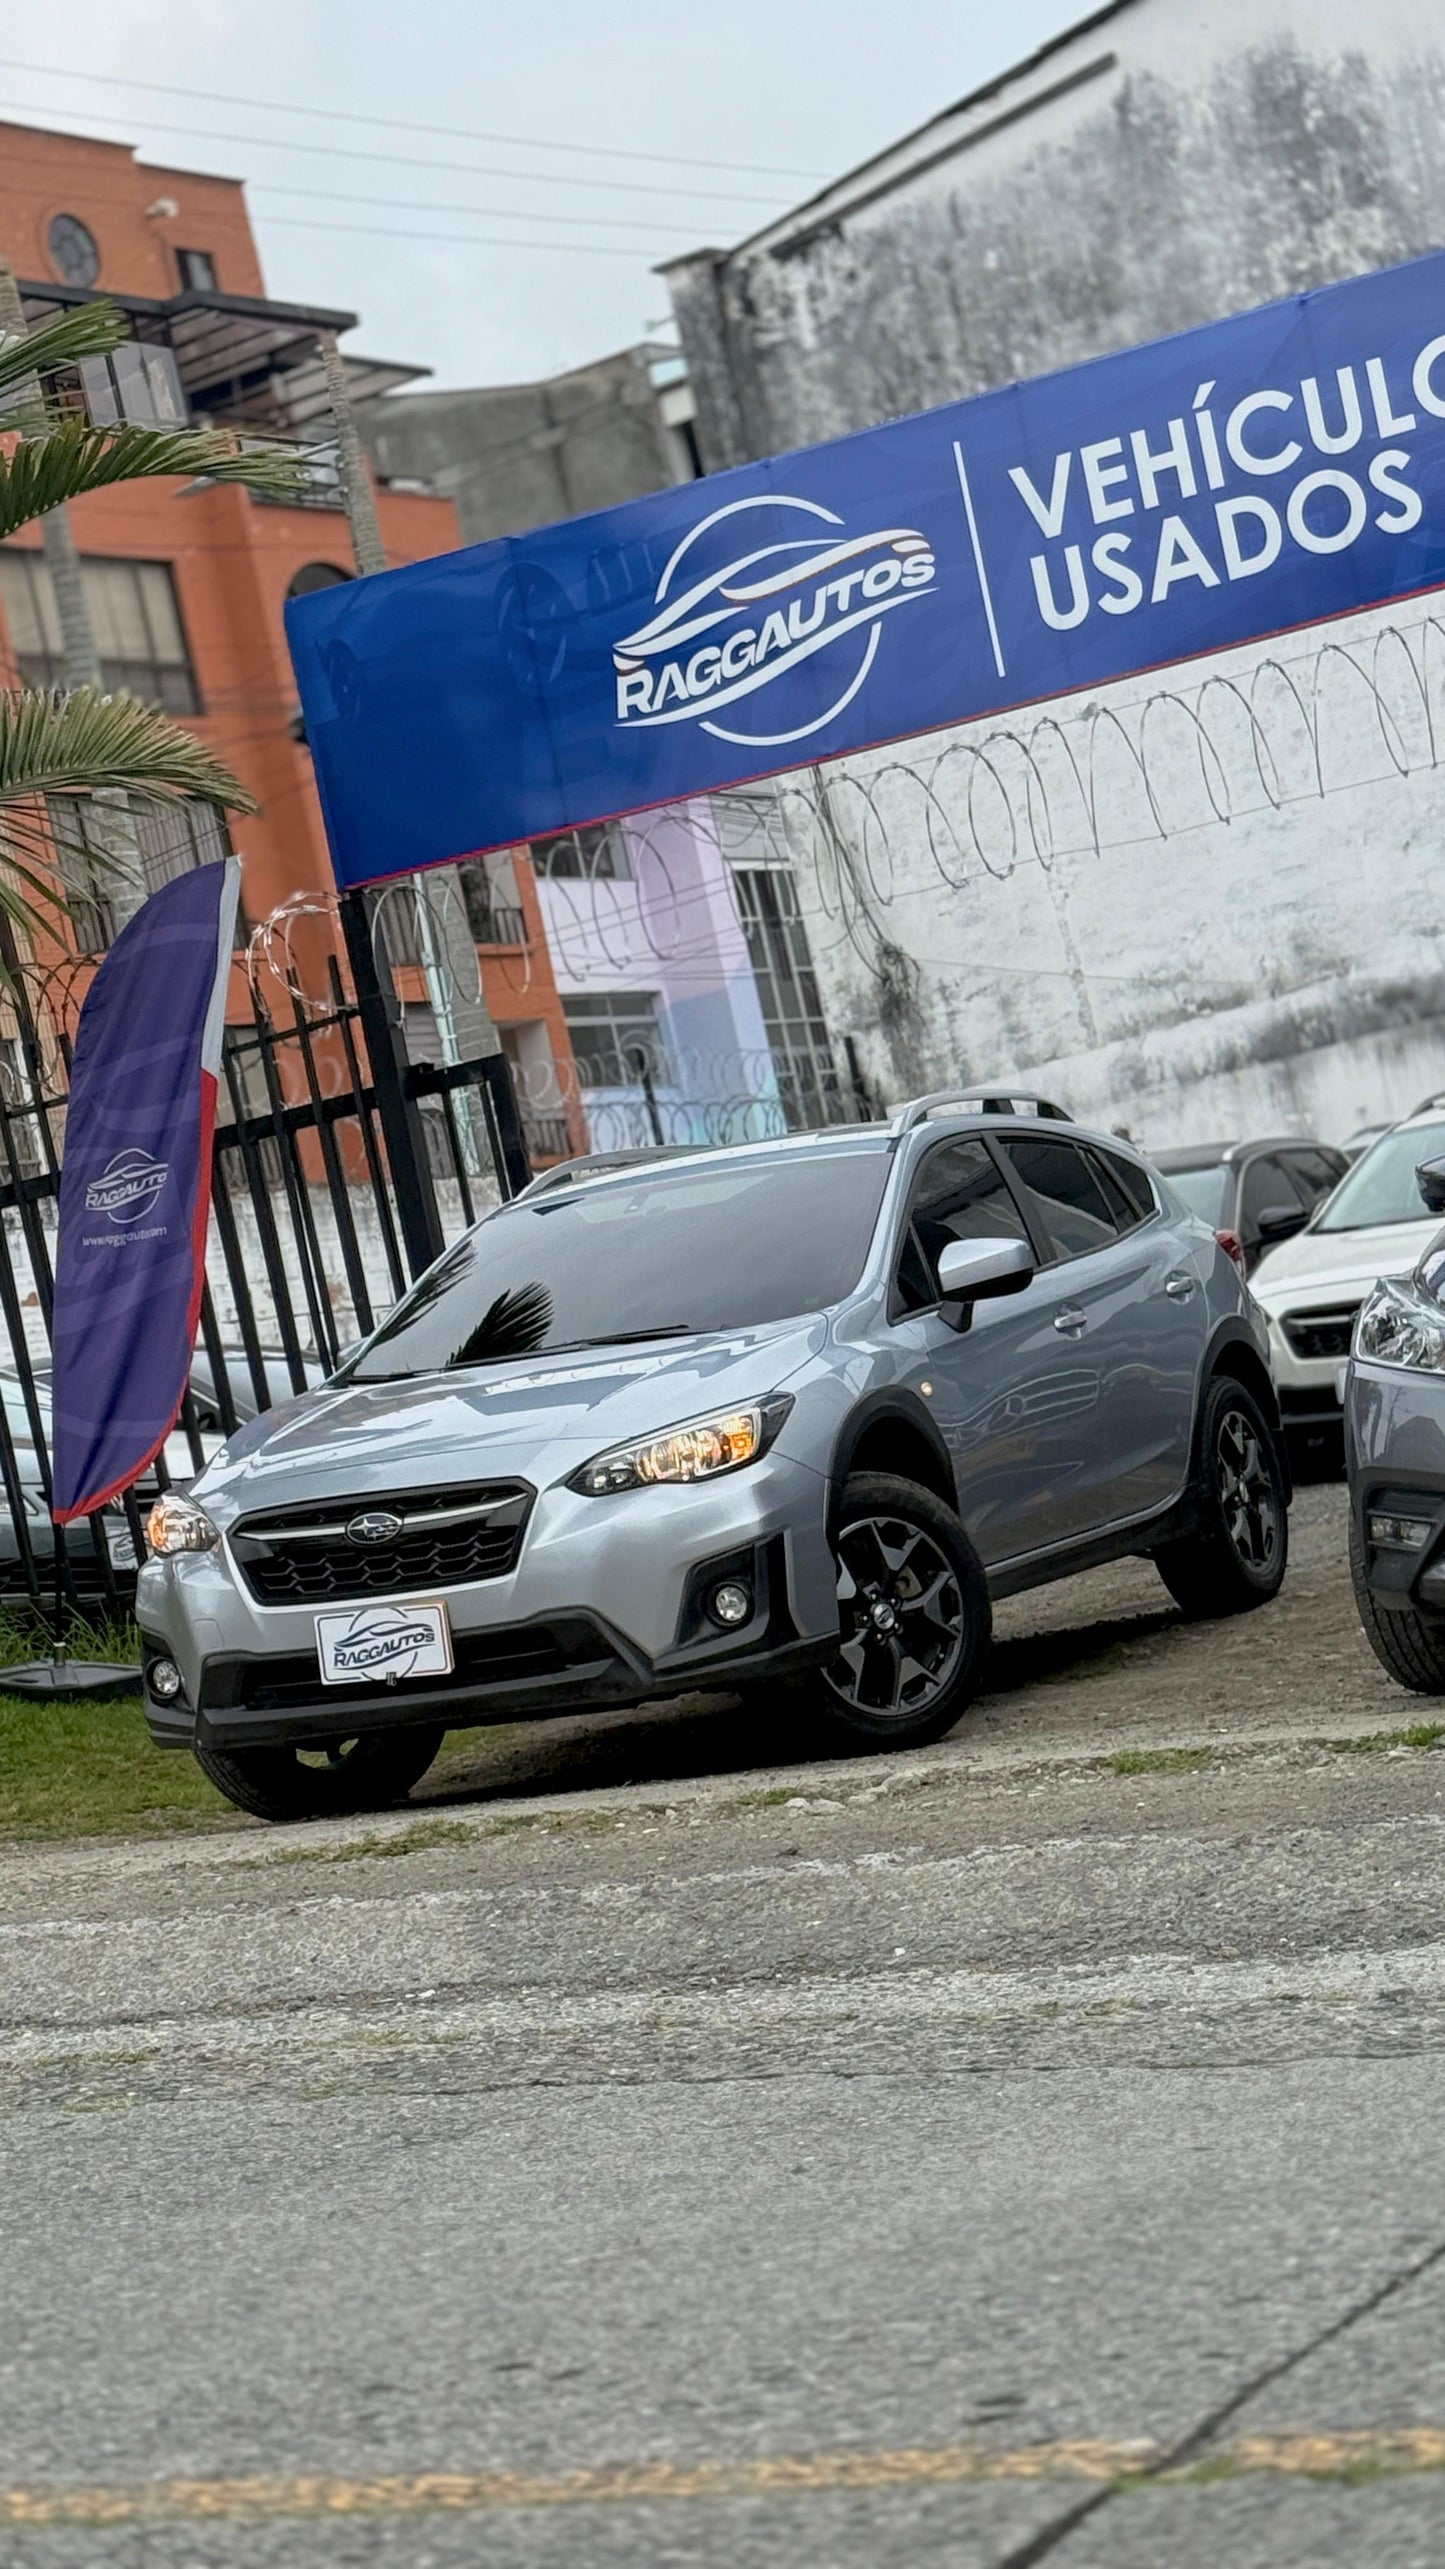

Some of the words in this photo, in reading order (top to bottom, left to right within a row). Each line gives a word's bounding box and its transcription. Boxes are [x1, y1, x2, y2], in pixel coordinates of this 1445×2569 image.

[1029, 449, 1424, 632] USADOS
[616, 553, 936, 719] RAGGAUTOS
[333, 1632, 436, 1668] RAGGAUTOS
